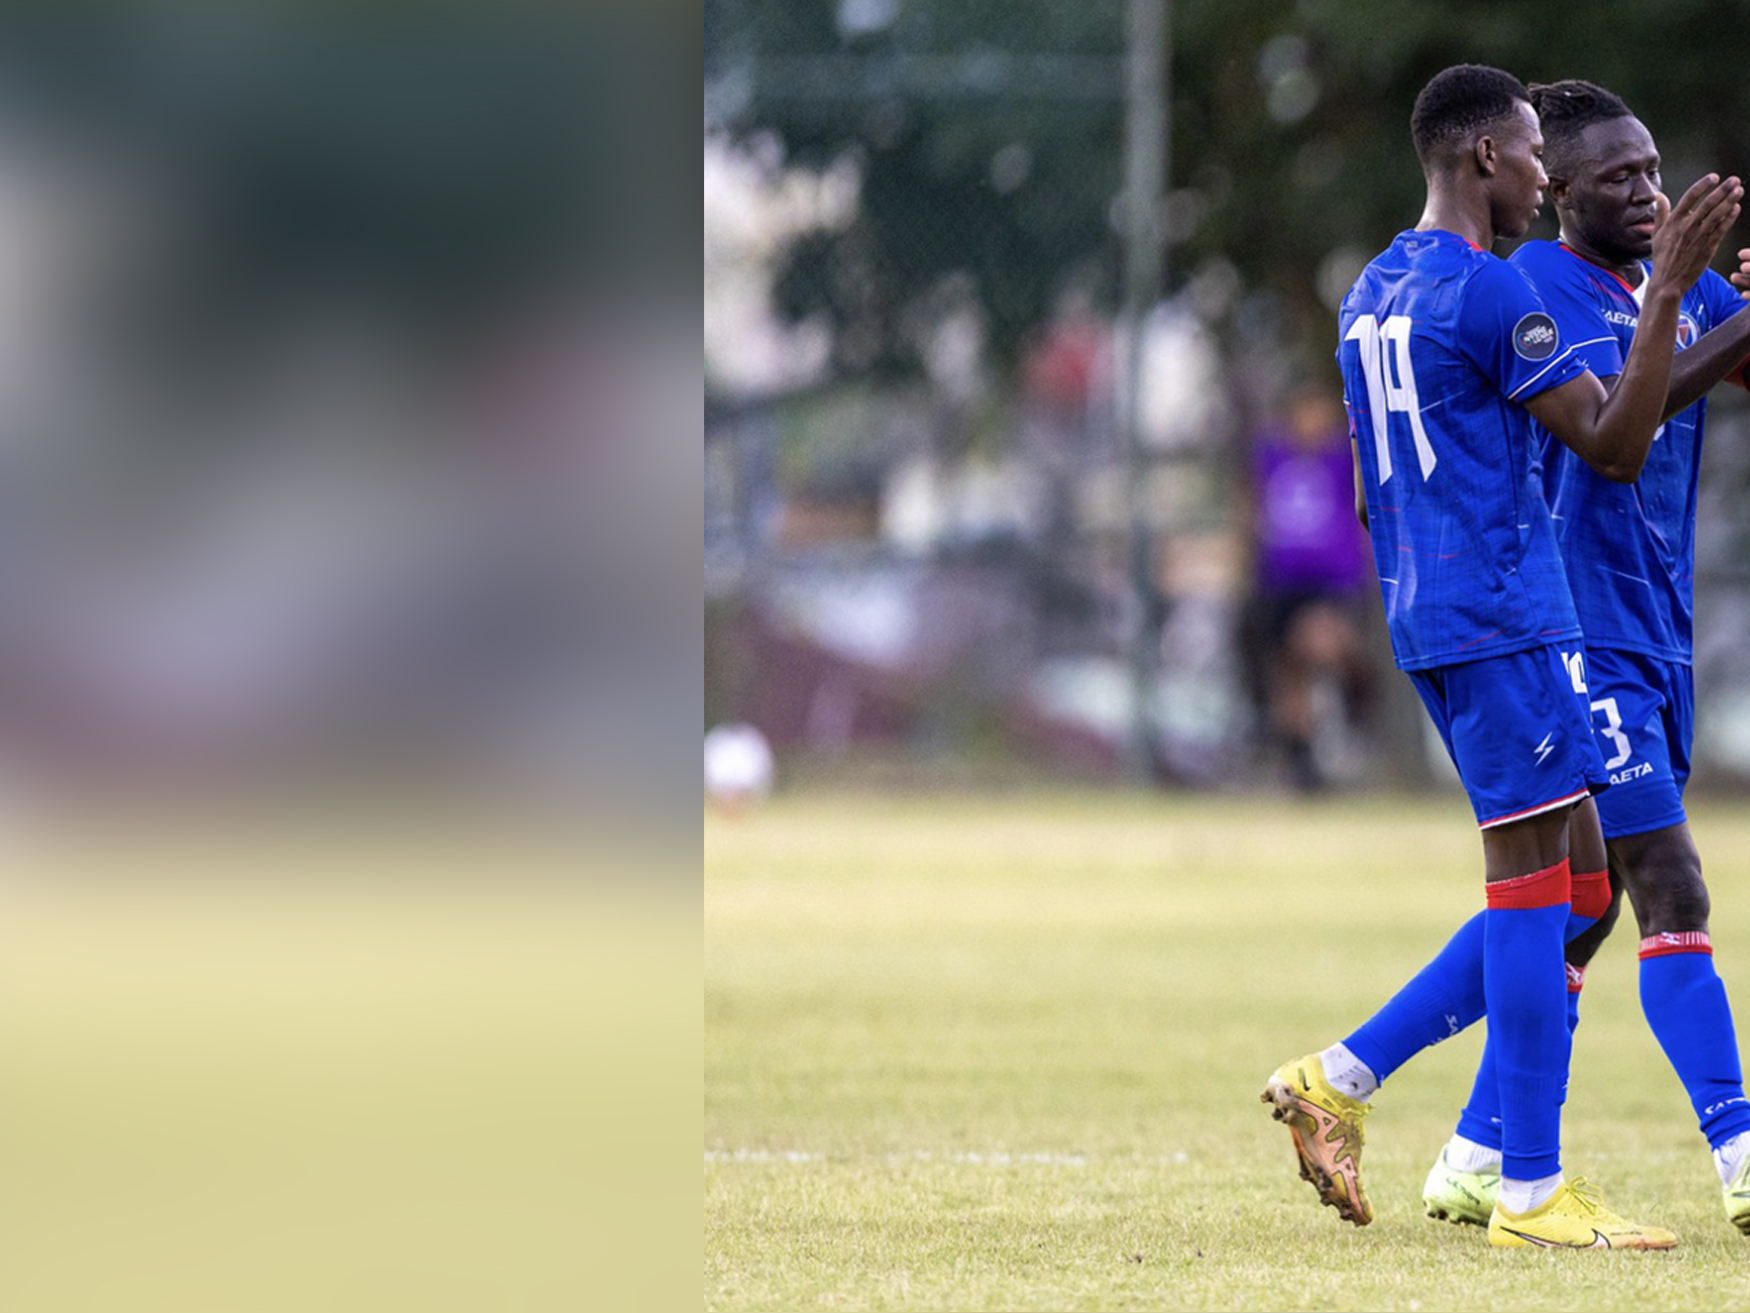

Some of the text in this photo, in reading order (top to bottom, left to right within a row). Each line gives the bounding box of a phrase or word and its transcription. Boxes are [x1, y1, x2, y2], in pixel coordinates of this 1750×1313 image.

[1602, 309, 1638, 328] AETA
[1344, 314, 1437, 486] 19
[1609, 761, 1653, 785] AETA
